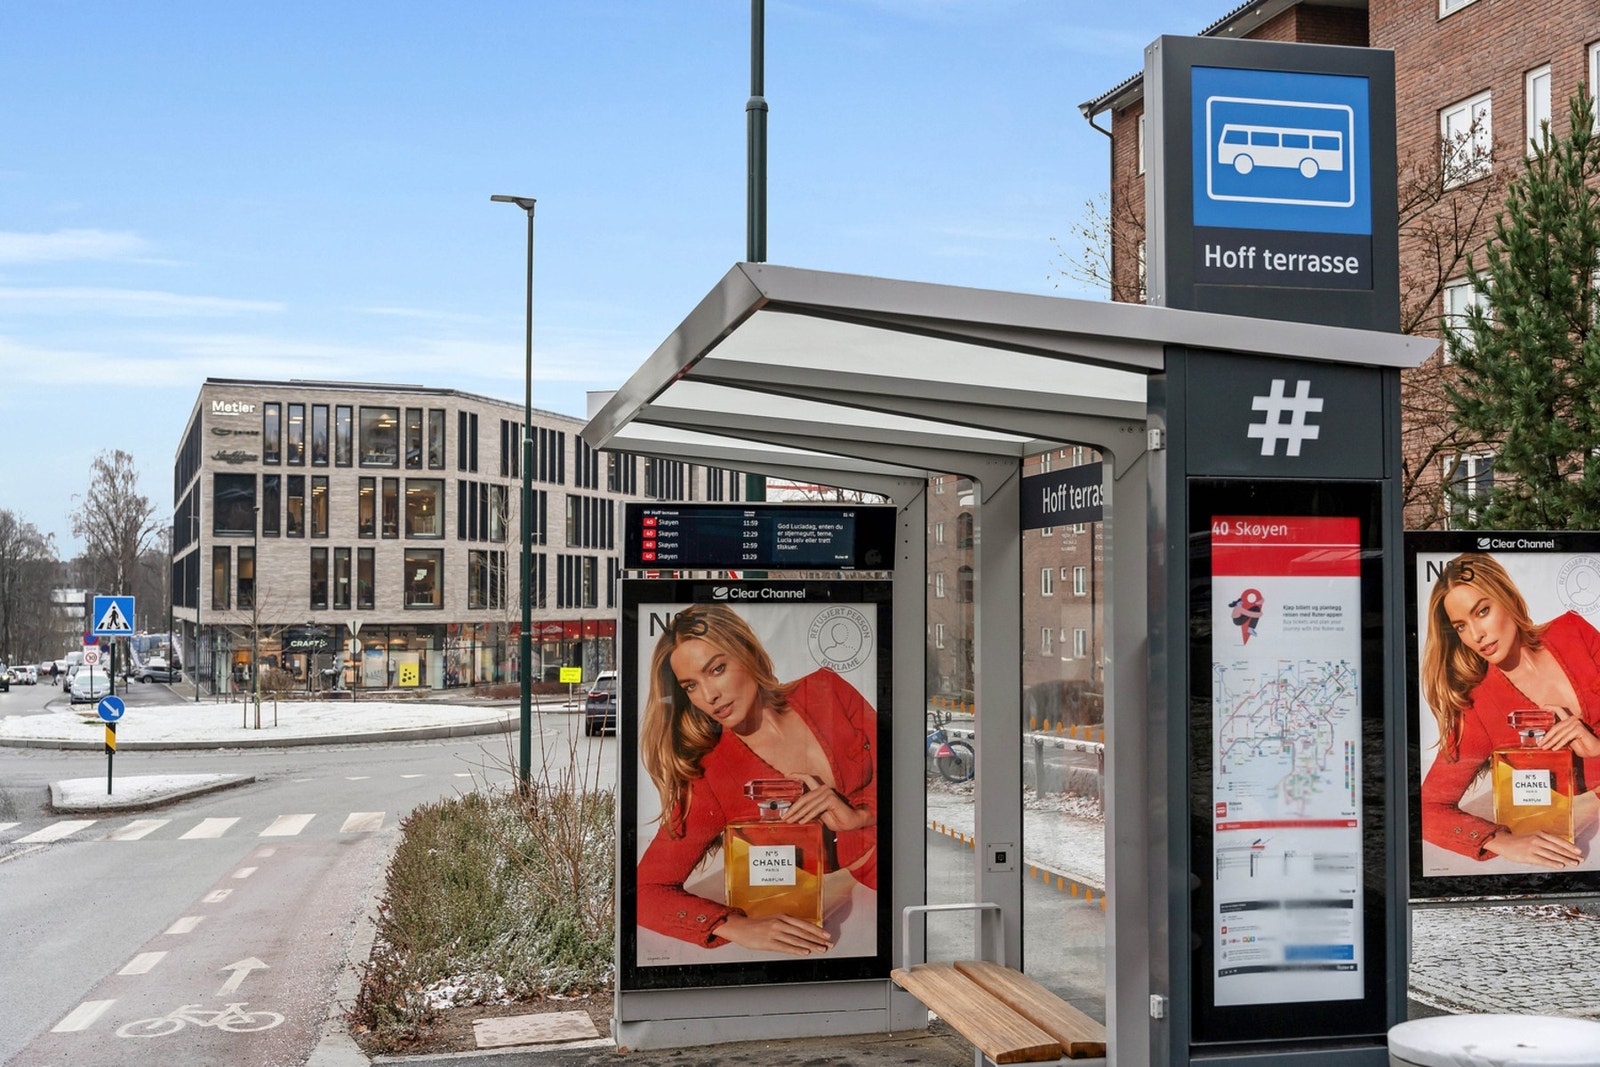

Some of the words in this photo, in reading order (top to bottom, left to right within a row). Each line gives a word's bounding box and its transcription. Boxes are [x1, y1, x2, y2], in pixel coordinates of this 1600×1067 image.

[1204, 244, 1256, 269] Hoff
[1263, 249, 1359, 274] terrasse
[212, 400, 256, 412] Metier
[1042, 483, 1067, 514] Hoff
[1212, 522, 1229, 535] 40
[1235, 522, 1288, 539] Skøyen
[1492, 539, 1516, 548] Clear
[1517, 539, 1554, 548] Channel
[730, 588, 759, 598] Clear
[761, 588, 805, 598] Channel
[650, 612, 708, 636] N°5
[810, 608, 845, 639] RETUSJERT
[847, 610, 870, 638] PERSON
[290, 639, 320, 648] CRAFT
[821, 658, 860, 670] REKLAME
